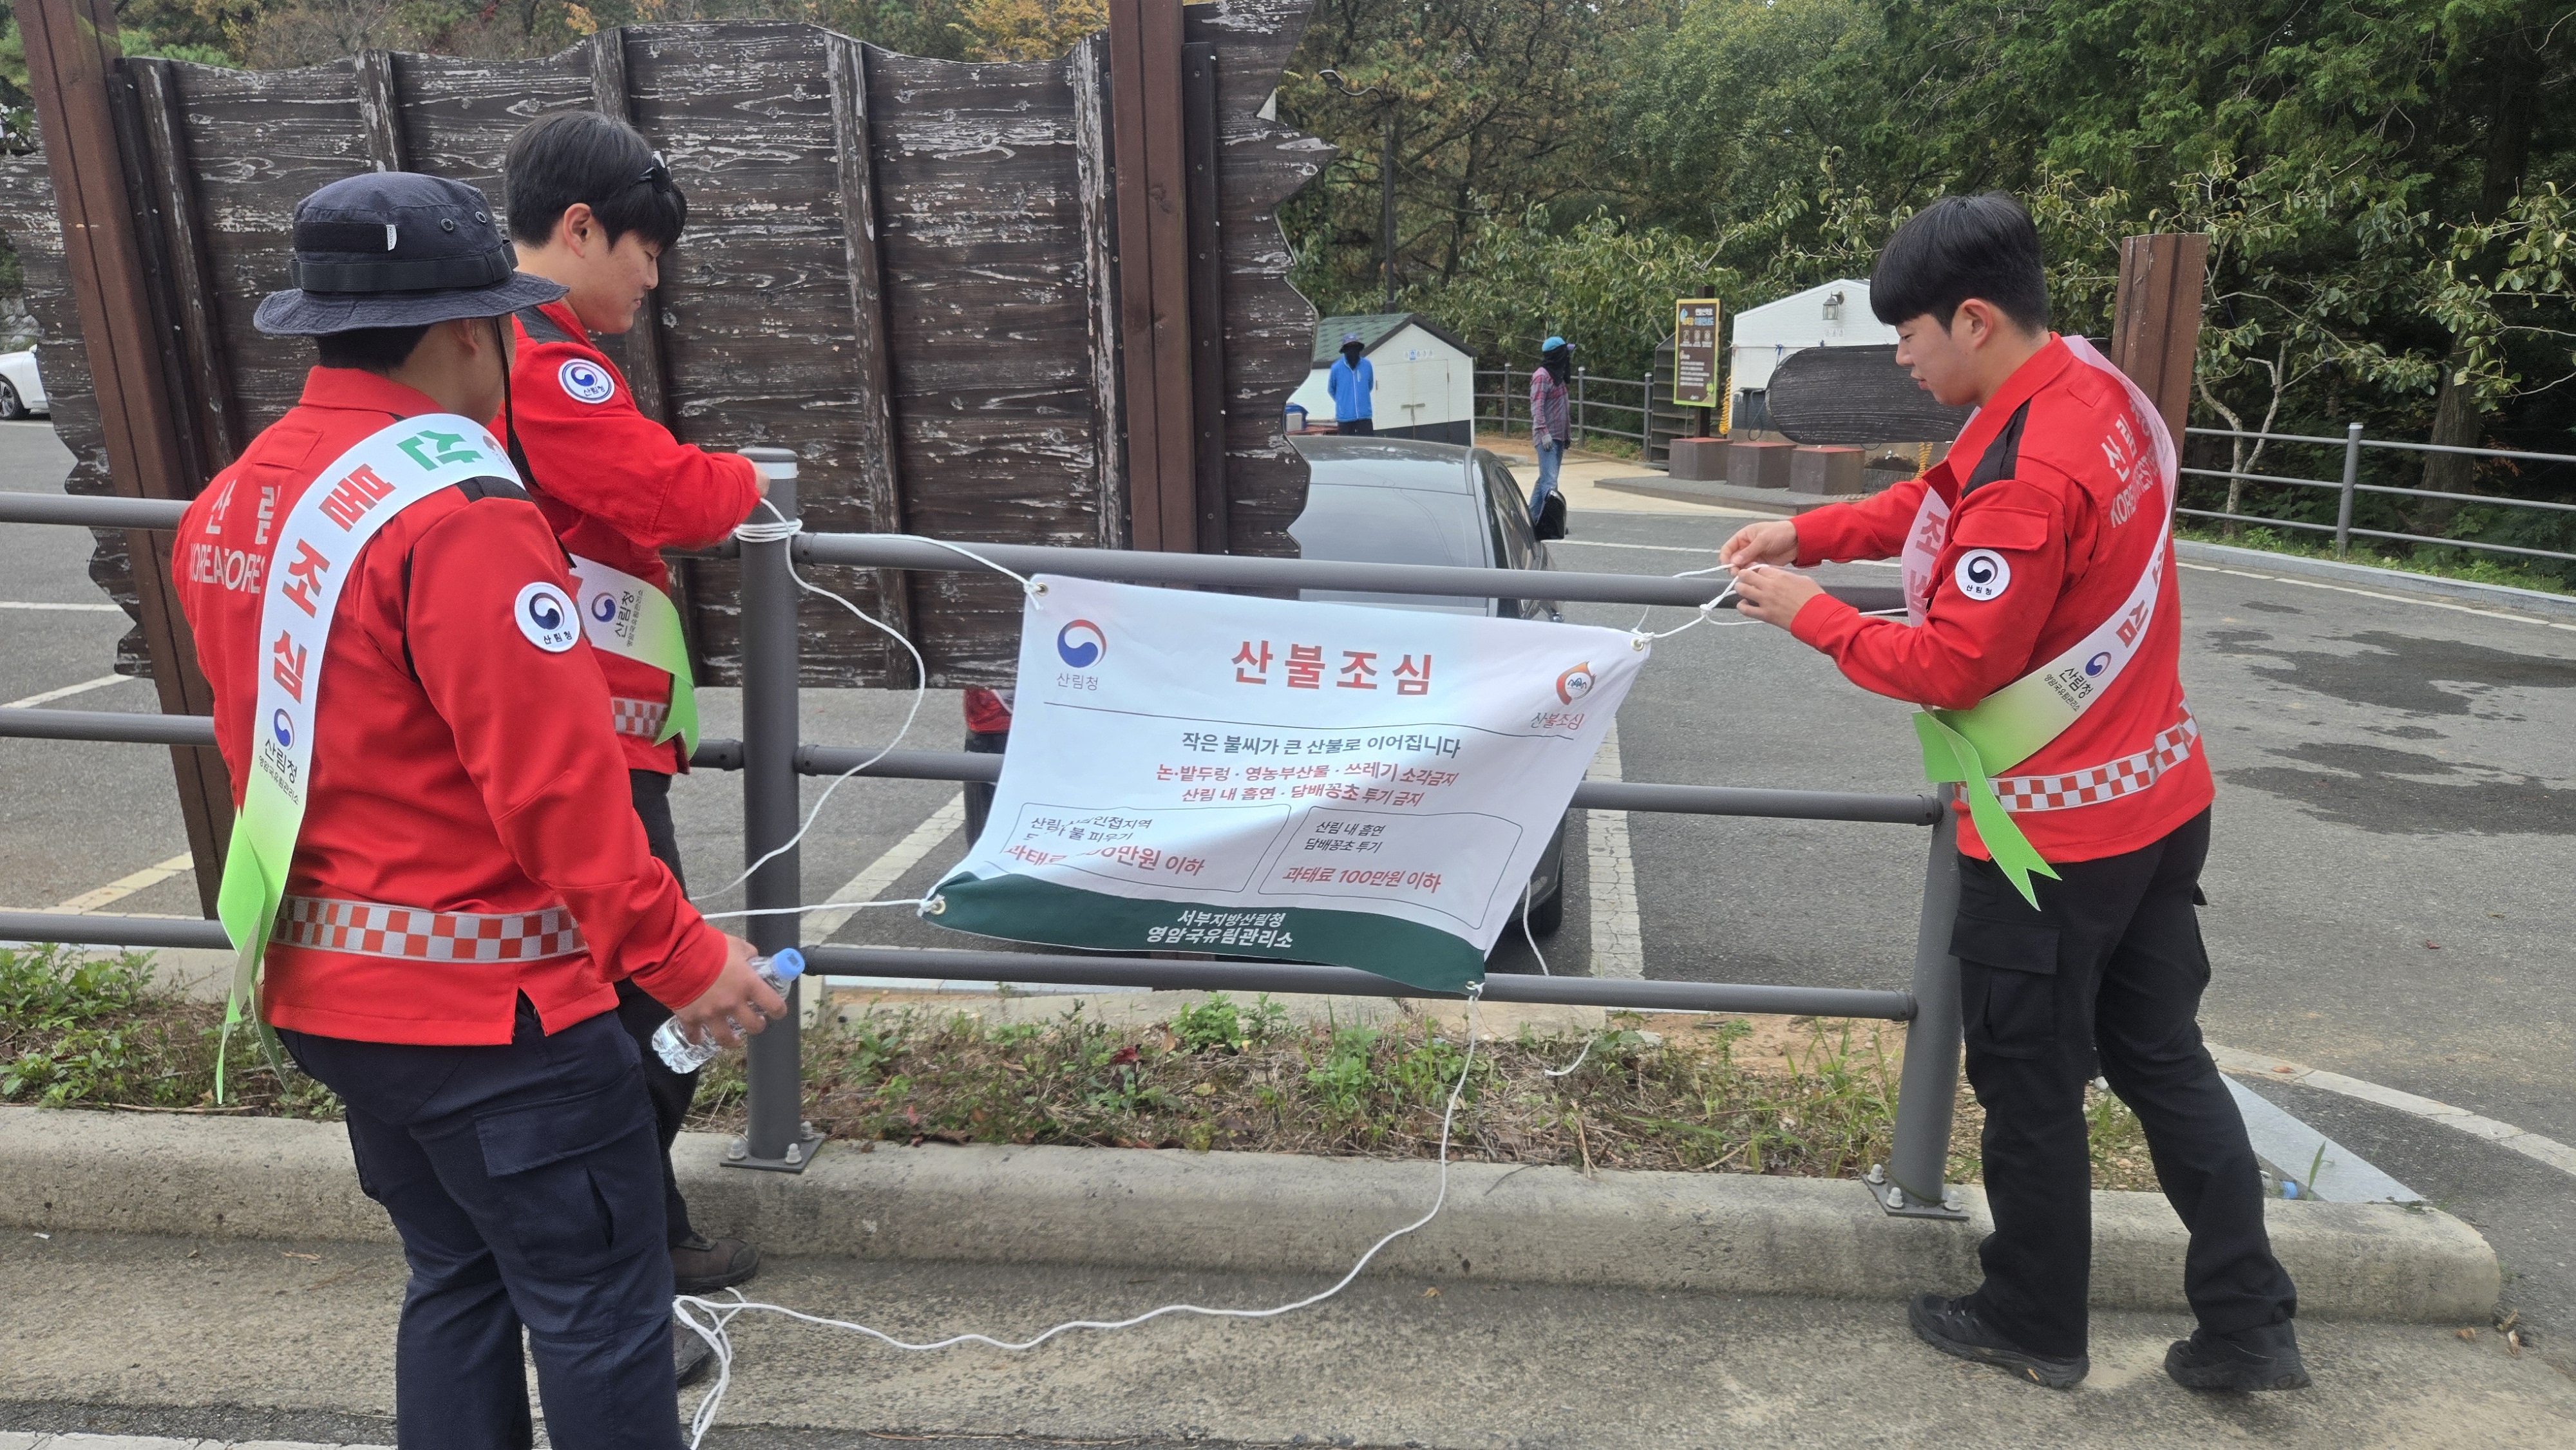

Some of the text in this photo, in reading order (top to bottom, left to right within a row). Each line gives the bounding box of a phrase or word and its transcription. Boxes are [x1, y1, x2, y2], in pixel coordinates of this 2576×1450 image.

[2110, 484, 2137, 529] KORE
[1966, 585, 1992, 596] 산림청
[615, 590, 635, 638] 산림청
[544, 631, 572, 645] 산림청
[1056, 672, 1099, 691] 산림청
[2059, 668, 2094, 699] 산림청
[1530, 712, 1585, 730] 산불조심
[1182, 732, 1461, 758] 작은 불씨가 큰 산불로 이어집니다
[265, 738, 298, 784] 산림청
[1245, 765, 1330, 781] 영농부산물
[1343, 762, 1399, 782] 쓰레기
[1399, 767, 1459, 787] 소각금지
[1182, 783, 1425, 807] 산림 내 흡연 담배꽁초 투기 금지
[1069, 827, 1085, 840] 불
[1087, 832, 1133, 843] 피우기
[1315, 821, 1387, 836] 산림 내 흡연
[1304, 838, 1383, 854] 담배꽁초 투기
[1165, 856, 1206, 876] 이하
[1282, 867, 1442, 894] 과태료 100만원 이하
[1177, 910, 1286, 927] 서부지방산림청
[1146, 926, 1293, 948] 영암국유림관리소
